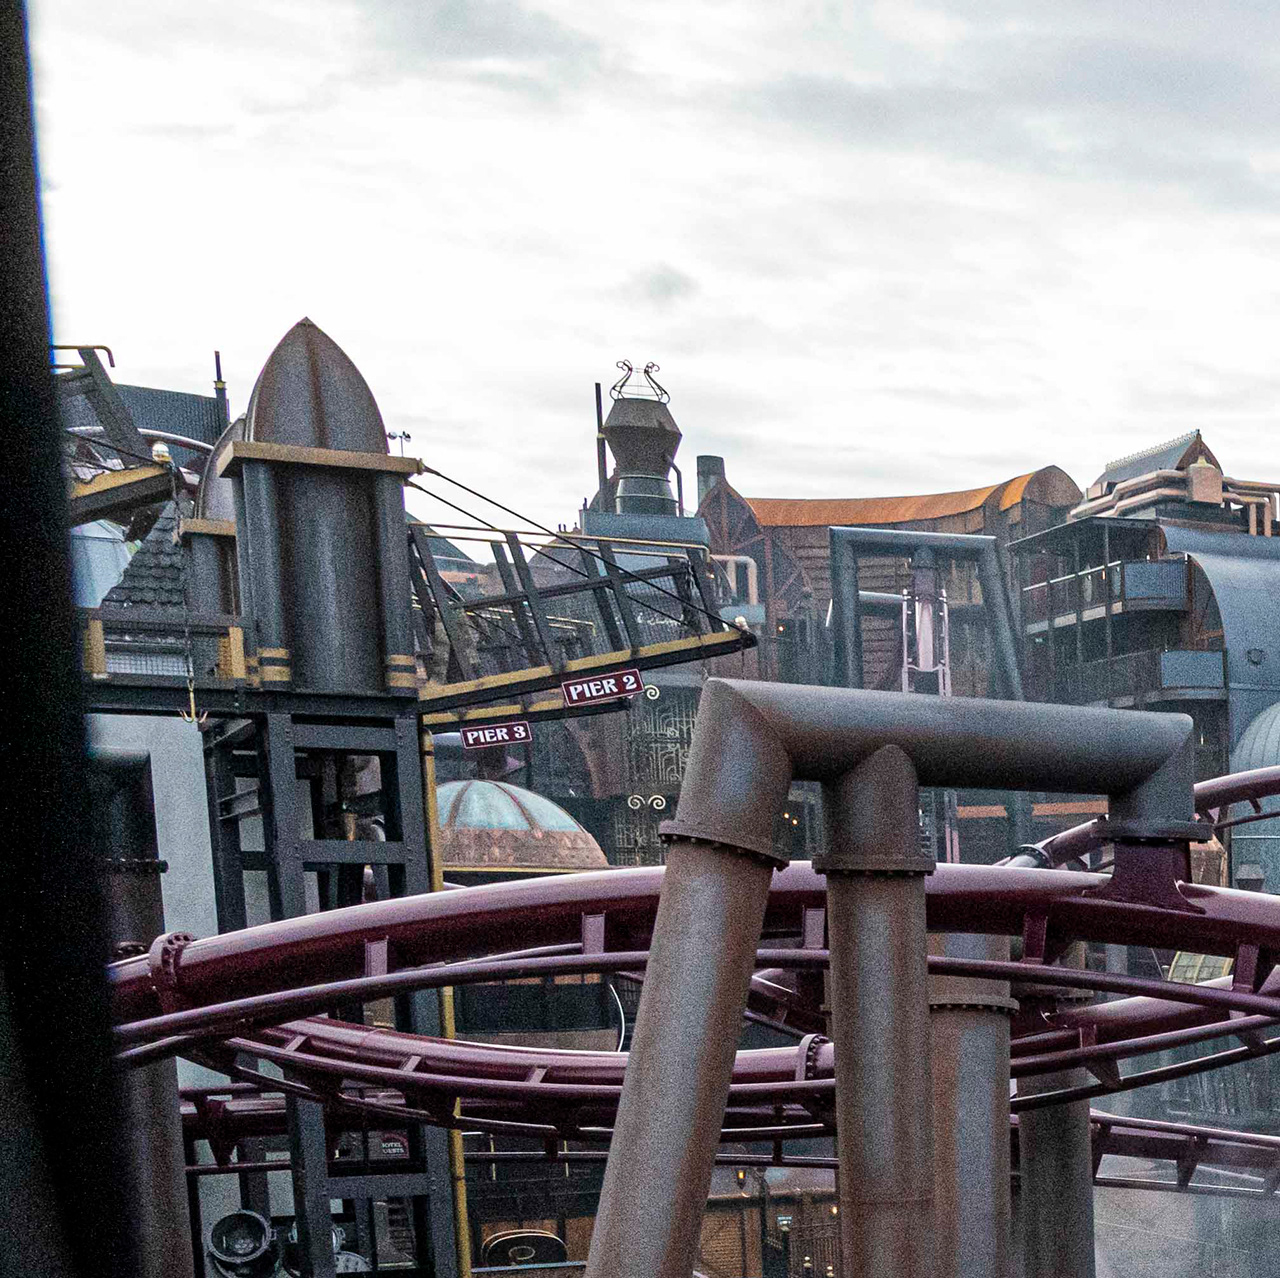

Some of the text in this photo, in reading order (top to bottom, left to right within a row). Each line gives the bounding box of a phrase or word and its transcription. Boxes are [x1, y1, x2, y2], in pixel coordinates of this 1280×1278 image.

[568, 674, 638, 701] PIER 2
[466, 725, 527, 745] PIER 3
